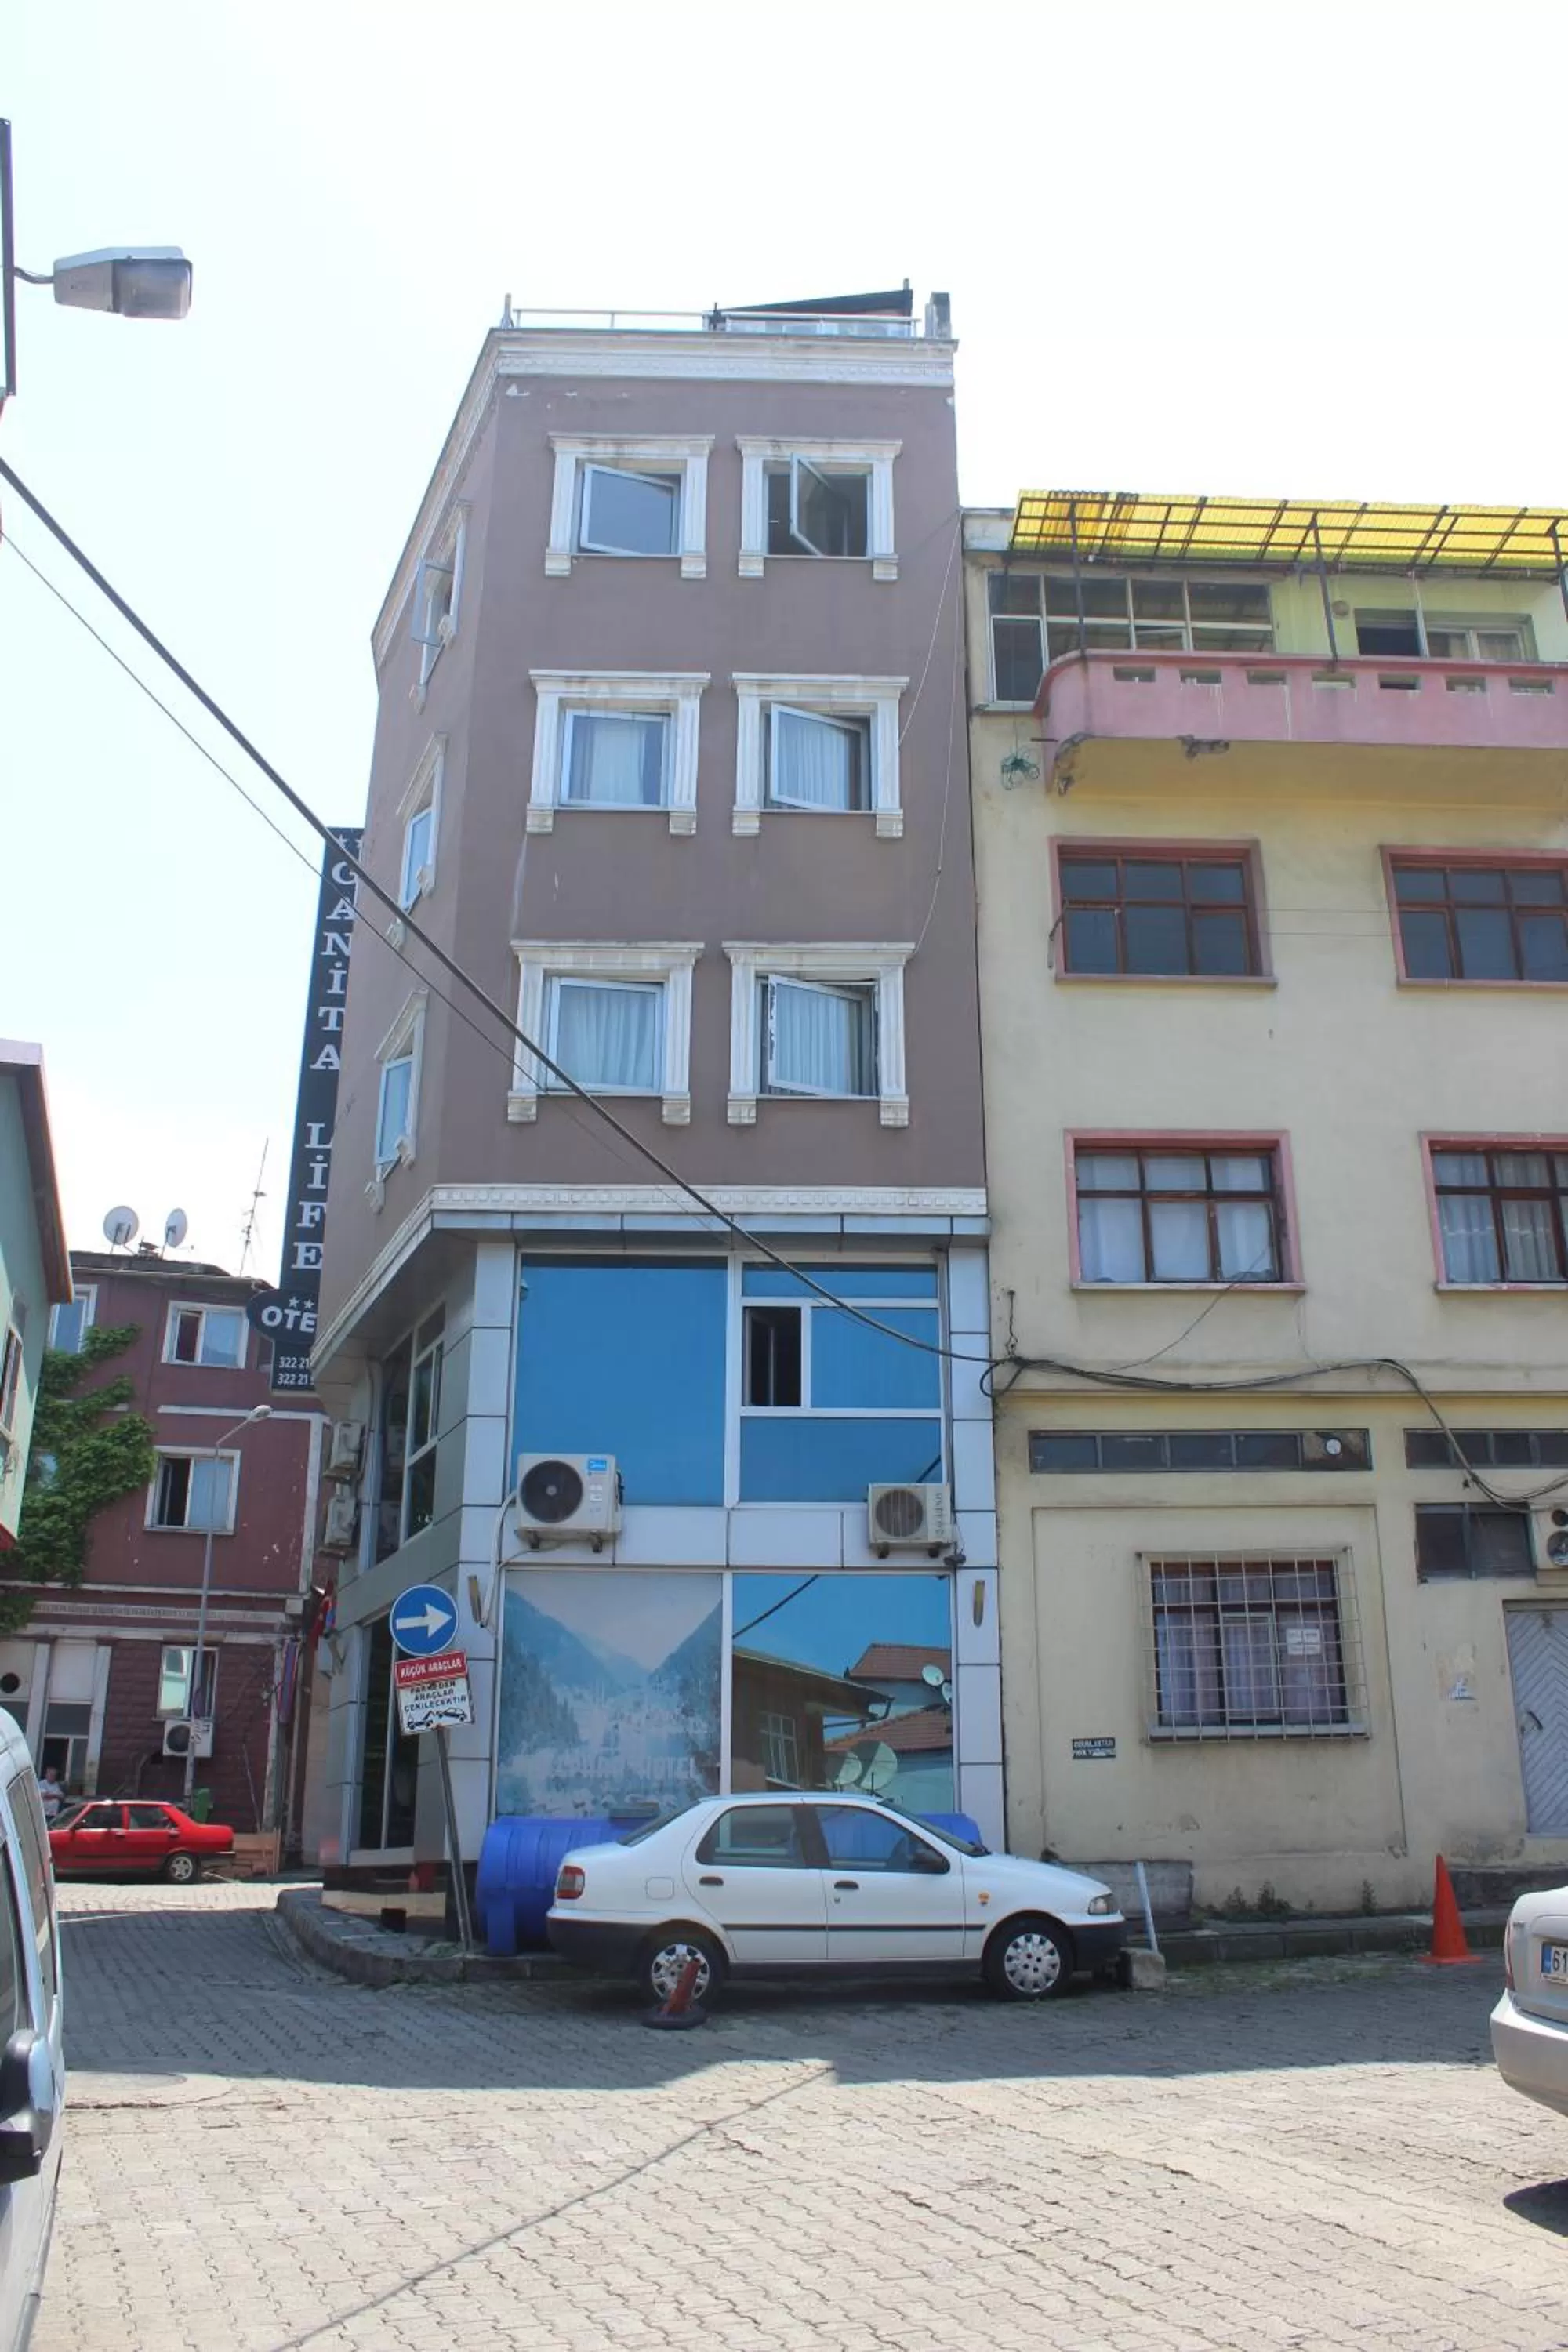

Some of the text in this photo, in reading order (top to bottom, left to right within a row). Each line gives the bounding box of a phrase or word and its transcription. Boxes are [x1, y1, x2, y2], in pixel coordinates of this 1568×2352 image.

[291, 1123, 332, 1269] LİFE
[278, 1356, 297, 1368] 322
[278, 1373, 296, 1385] 322
[298, 1374, 308, 1385] 21
[428, 1658, 462, 1672] ARAÇLAR
[415, 1689, 454, 1701] ARAÇLAR
[1553, 1949, 1568, 1973] 61
